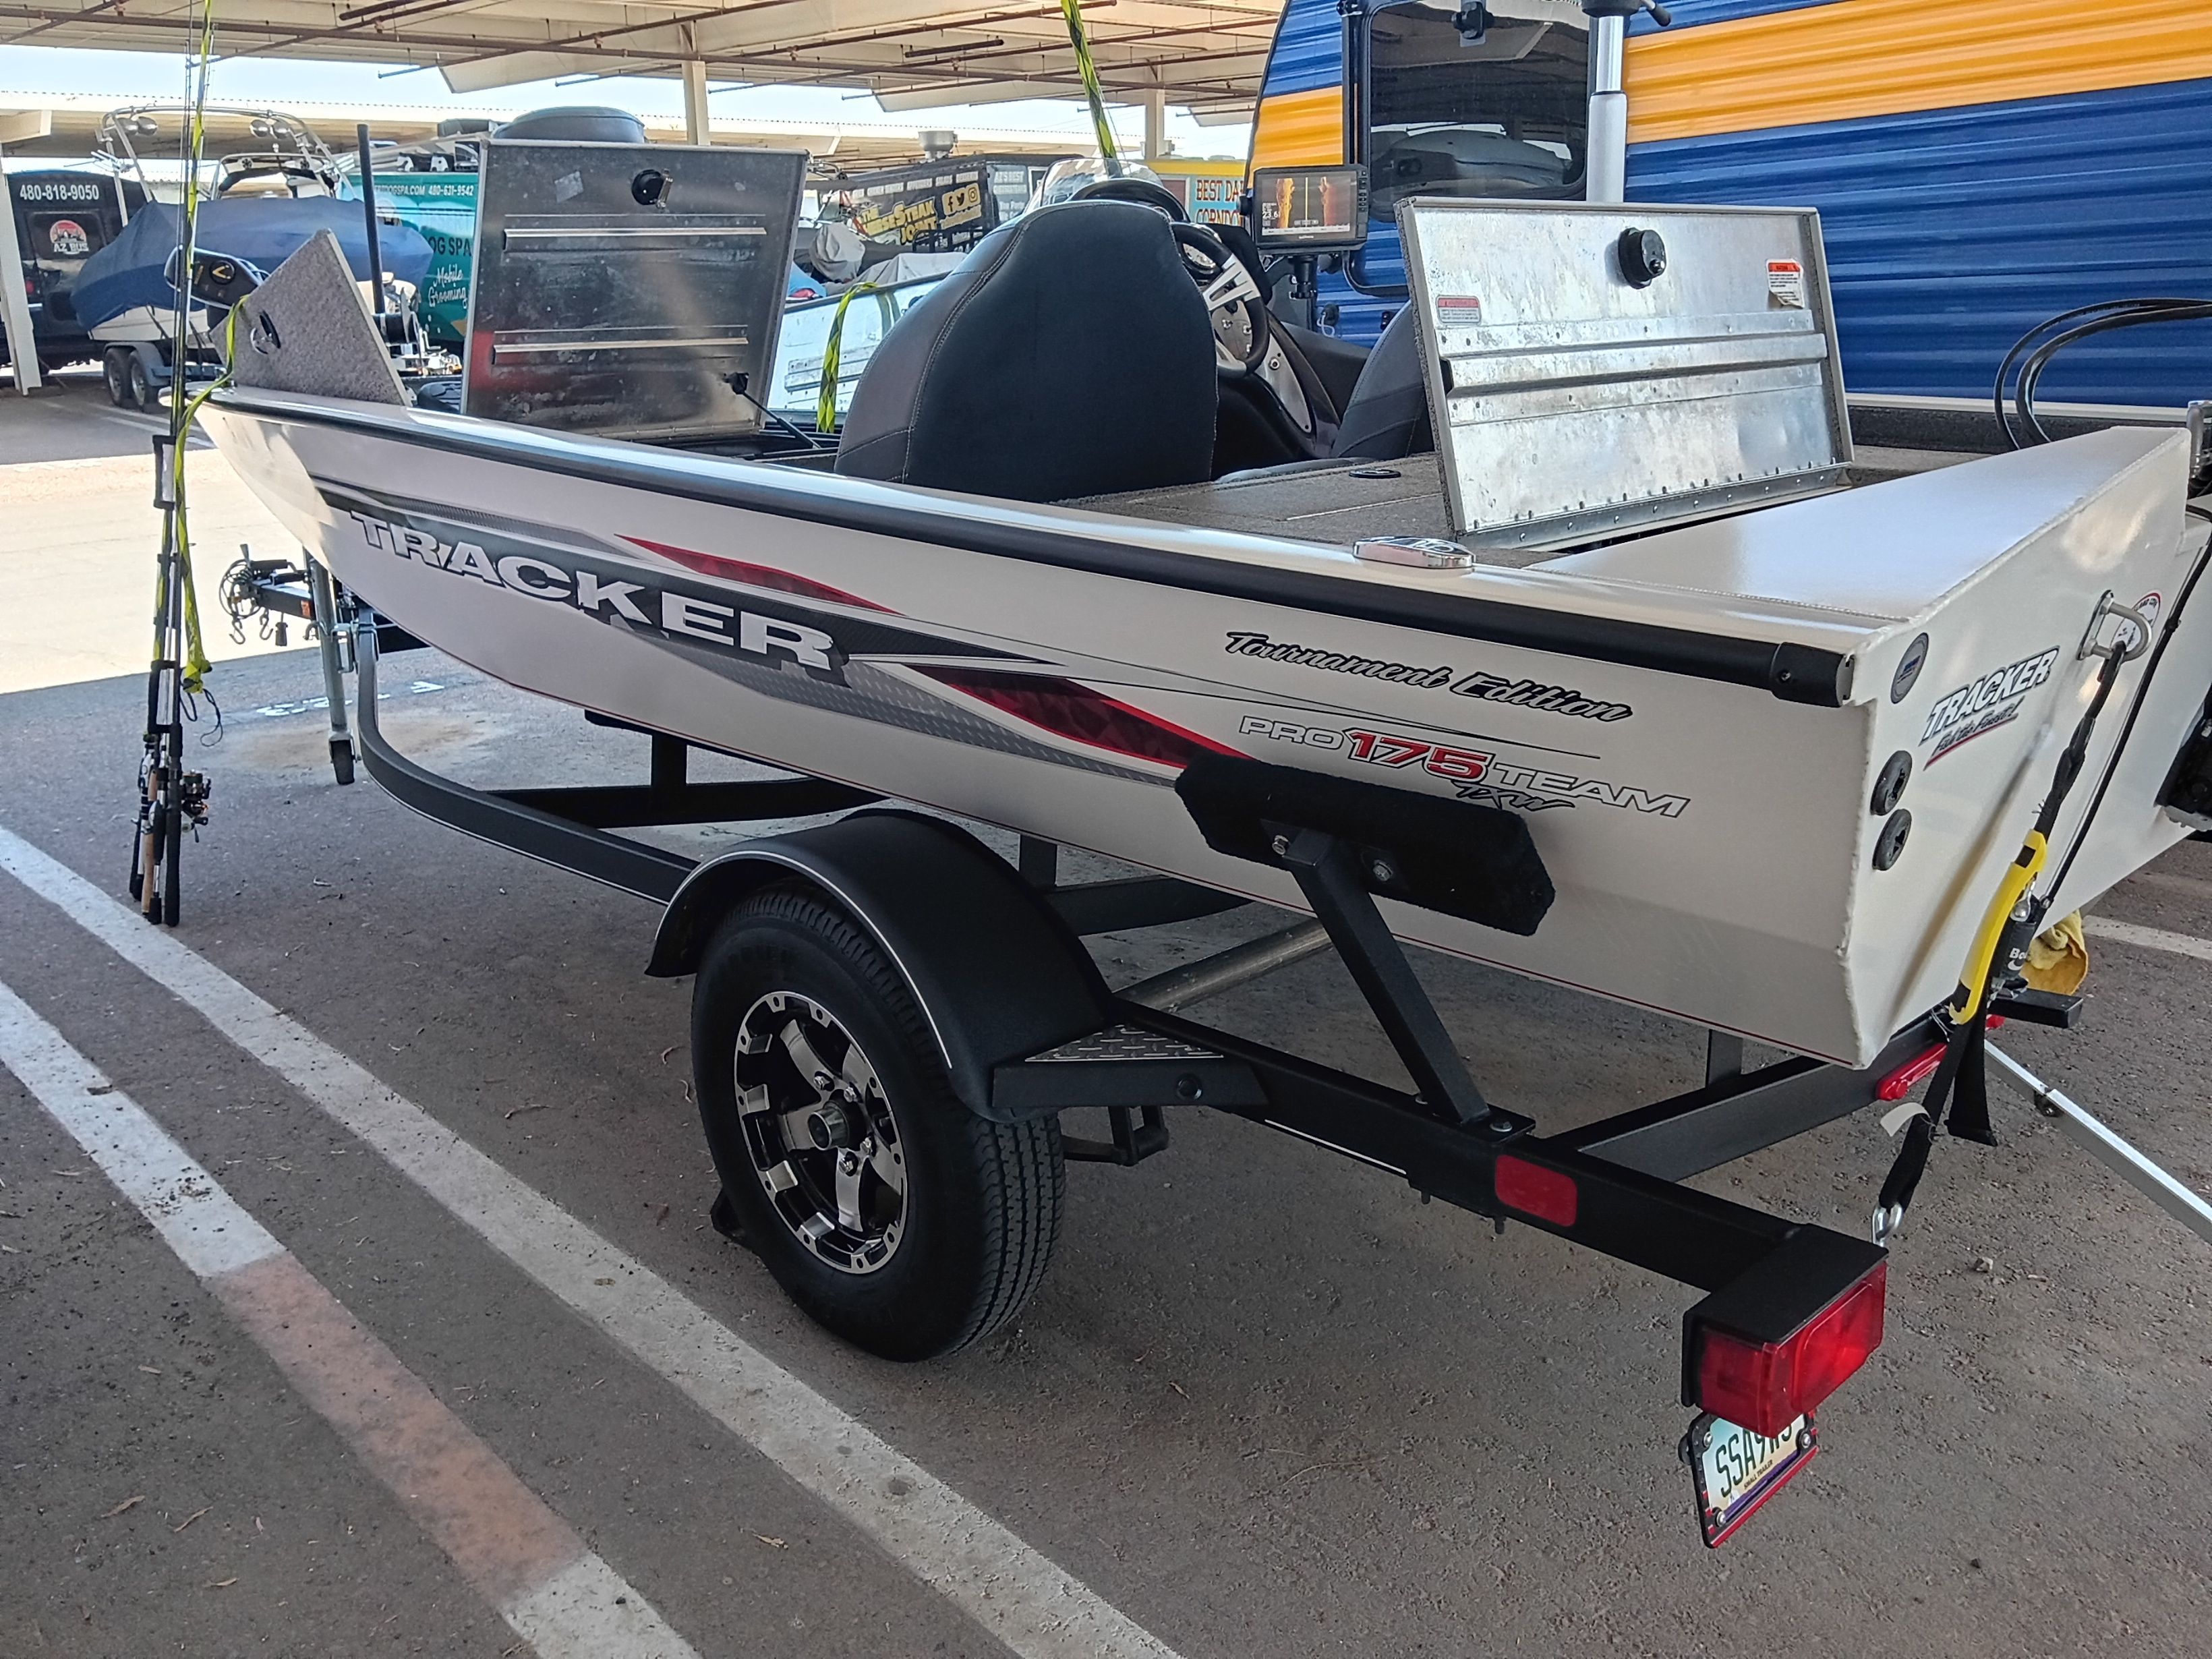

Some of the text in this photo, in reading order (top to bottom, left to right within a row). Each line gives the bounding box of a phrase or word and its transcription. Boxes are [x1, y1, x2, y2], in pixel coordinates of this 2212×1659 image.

[20, 184, 99, 200] 480-818-9050
[428, 185, 474, 196] 480-631-9542
[1196, 179, 1223, 201] BEST
[53, 243, 89, 252] AZ BUS
[448, 237, 472, 256] SPA
[433, 264, 463, 288] Mobile
[428, 287, 468, 309] Grooming
[349, 510, 842, 677] TRACKER
[1225, 632, 1633, 722] Tournament Edition
[1919, 645, 2060, 746] TRACKER
[1239, 716, 1691, 818] PRO 175 TEAM
[1744, 1459, 1773, 1489] SMALL TRAILER
